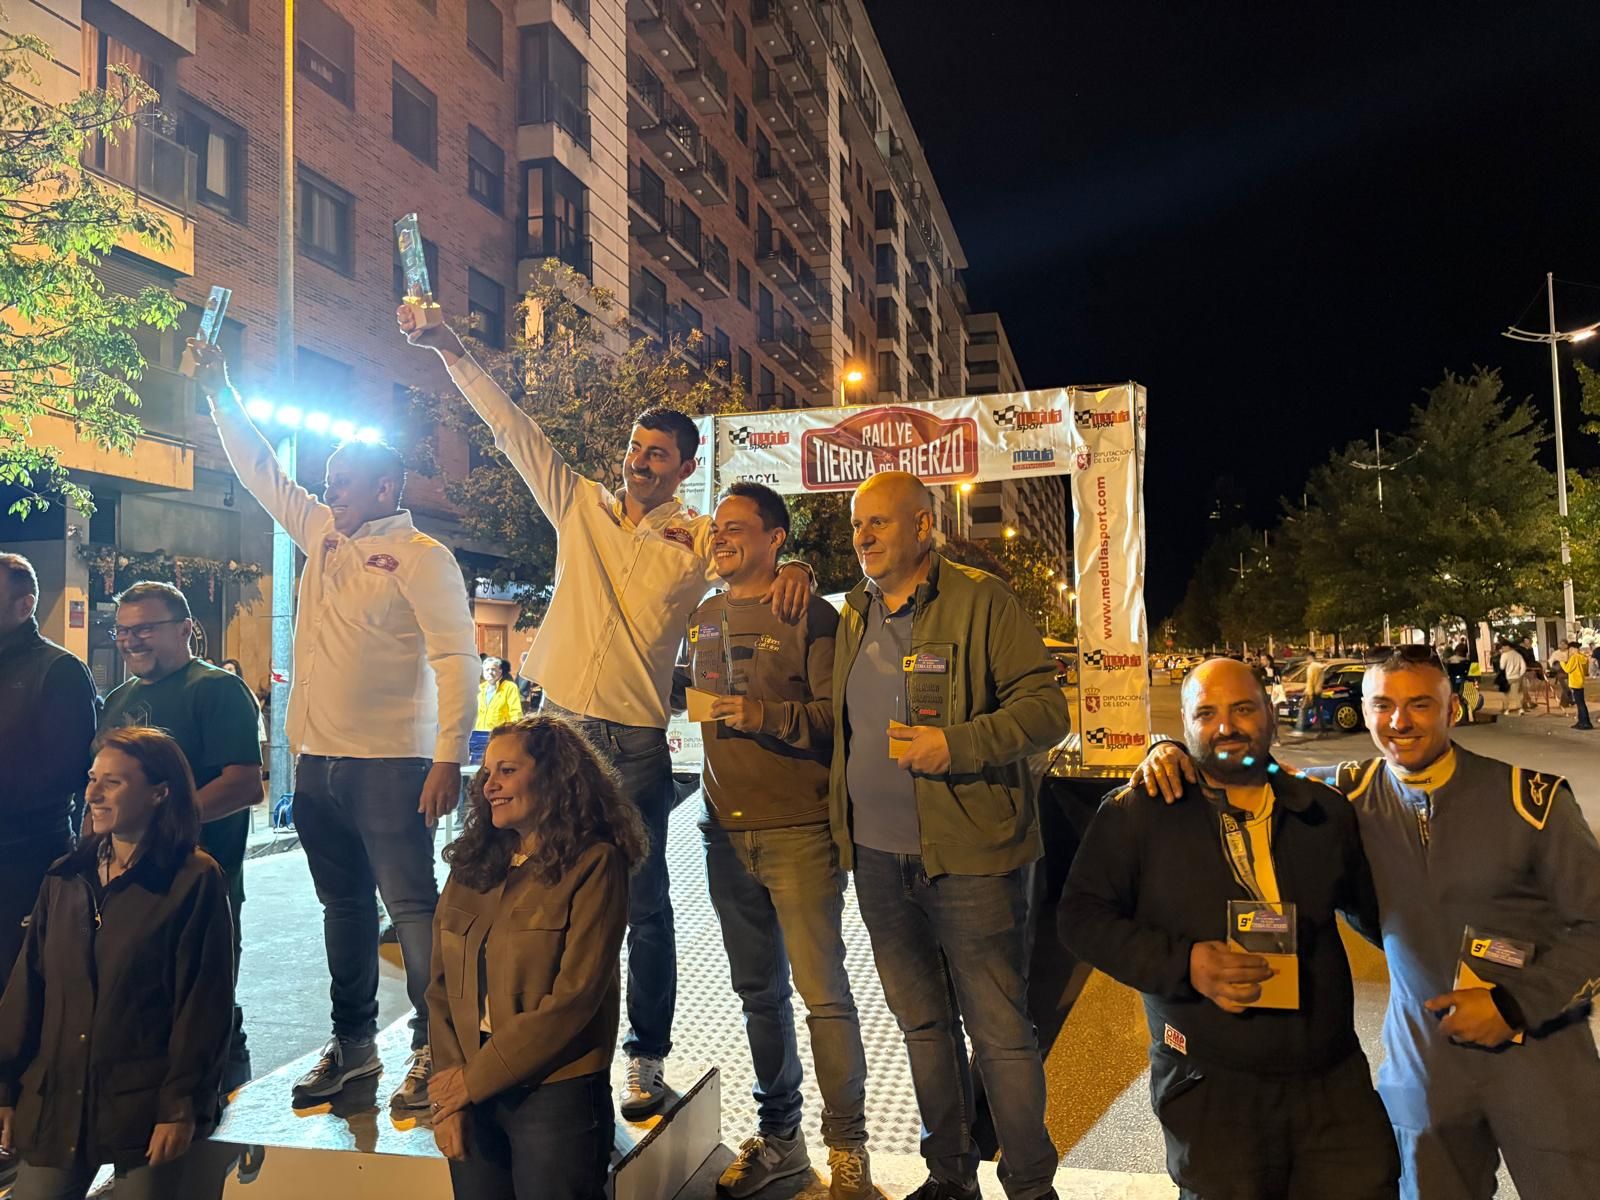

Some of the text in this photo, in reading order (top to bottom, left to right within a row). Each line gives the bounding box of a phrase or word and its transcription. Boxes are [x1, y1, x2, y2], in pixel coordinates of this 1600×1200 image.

[1016, 421, 1043, 433] sport
[1092, 420, 1114, 430] sport
[862, 421, 912, 447] RALLYE
[749, 442, 773, 453] sport
[813, 436, 876, 483] TIERRA
[899, 426, 964, 477] BIERZO
[1097, 476, 1112, 640] www.medulasport.com
[1103, 664, 1126, 673] sport
[1105, 742, 1128, 751] sport
[1167, 1030, 1185, 1044] OMP
